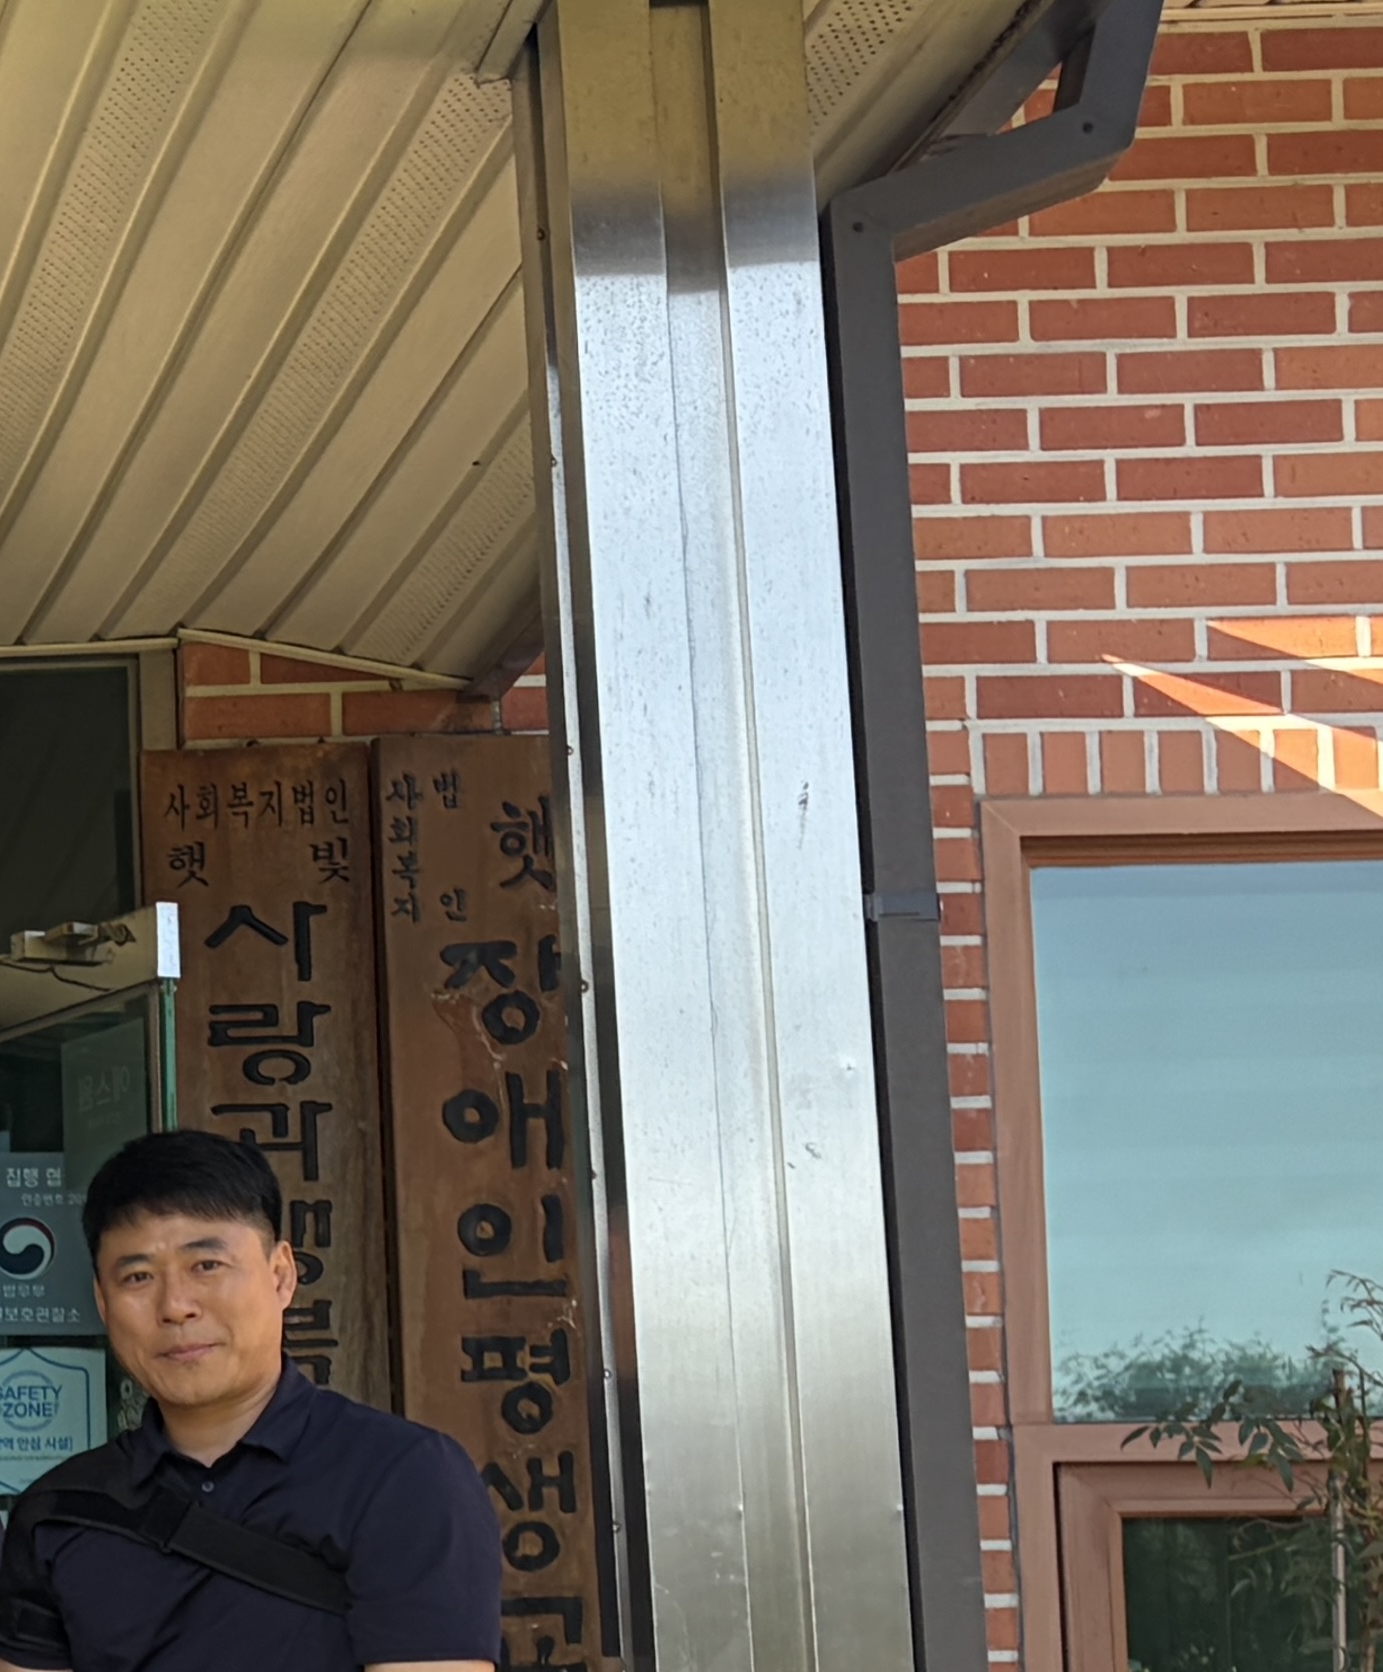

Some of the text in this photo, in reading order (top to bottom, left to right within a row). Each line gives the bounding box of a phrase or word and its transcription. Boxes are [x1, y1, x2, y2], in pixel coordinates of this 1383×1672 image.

[163, 778, 351, 831] 사회복지법인
[385, 770, 424, 926] 사회복지
[165, 836, 352, 889] 햇빛
[6, 1167, 40, 1188] 집행
[2, 1283, 46, 1299] 법무부
[1, 1402, 54, 1419] ZONE
[17, 1436, 42, 1451] 안심
